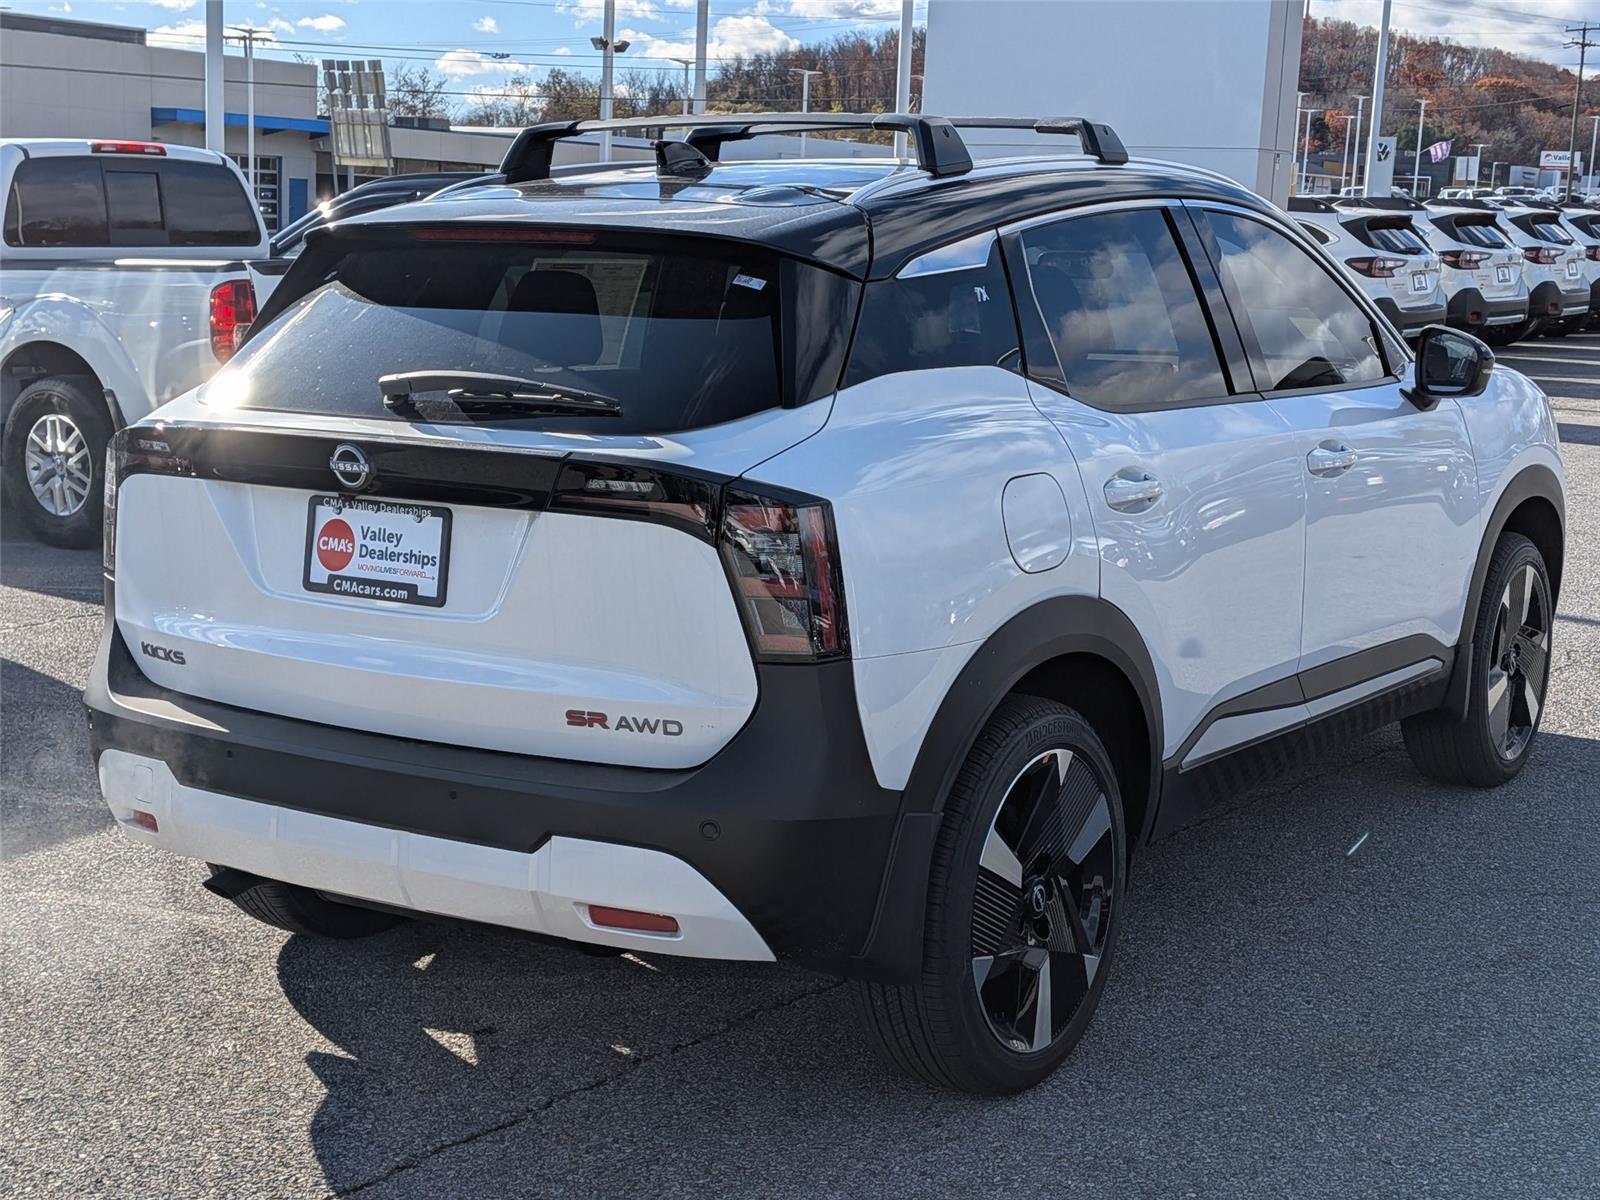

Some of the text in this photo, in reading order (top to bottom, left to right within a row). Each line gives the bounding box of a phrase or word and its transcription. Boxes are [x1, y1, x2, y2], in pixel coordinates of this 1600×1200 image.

[329, 460, 369, 473] NISSAN
[322, 497, 432, 518] CMAs Valley Dealerships
[319, 537, 353, 553] CMA's
[361, 525, 403, 547] Valley
[359, 544, 437, 569] Dealerships
[333, 579, 408, 599] CMAcars.com
[141, 641, 186, 665] KICKS
[565, 709, 683, 736] SR AWD
